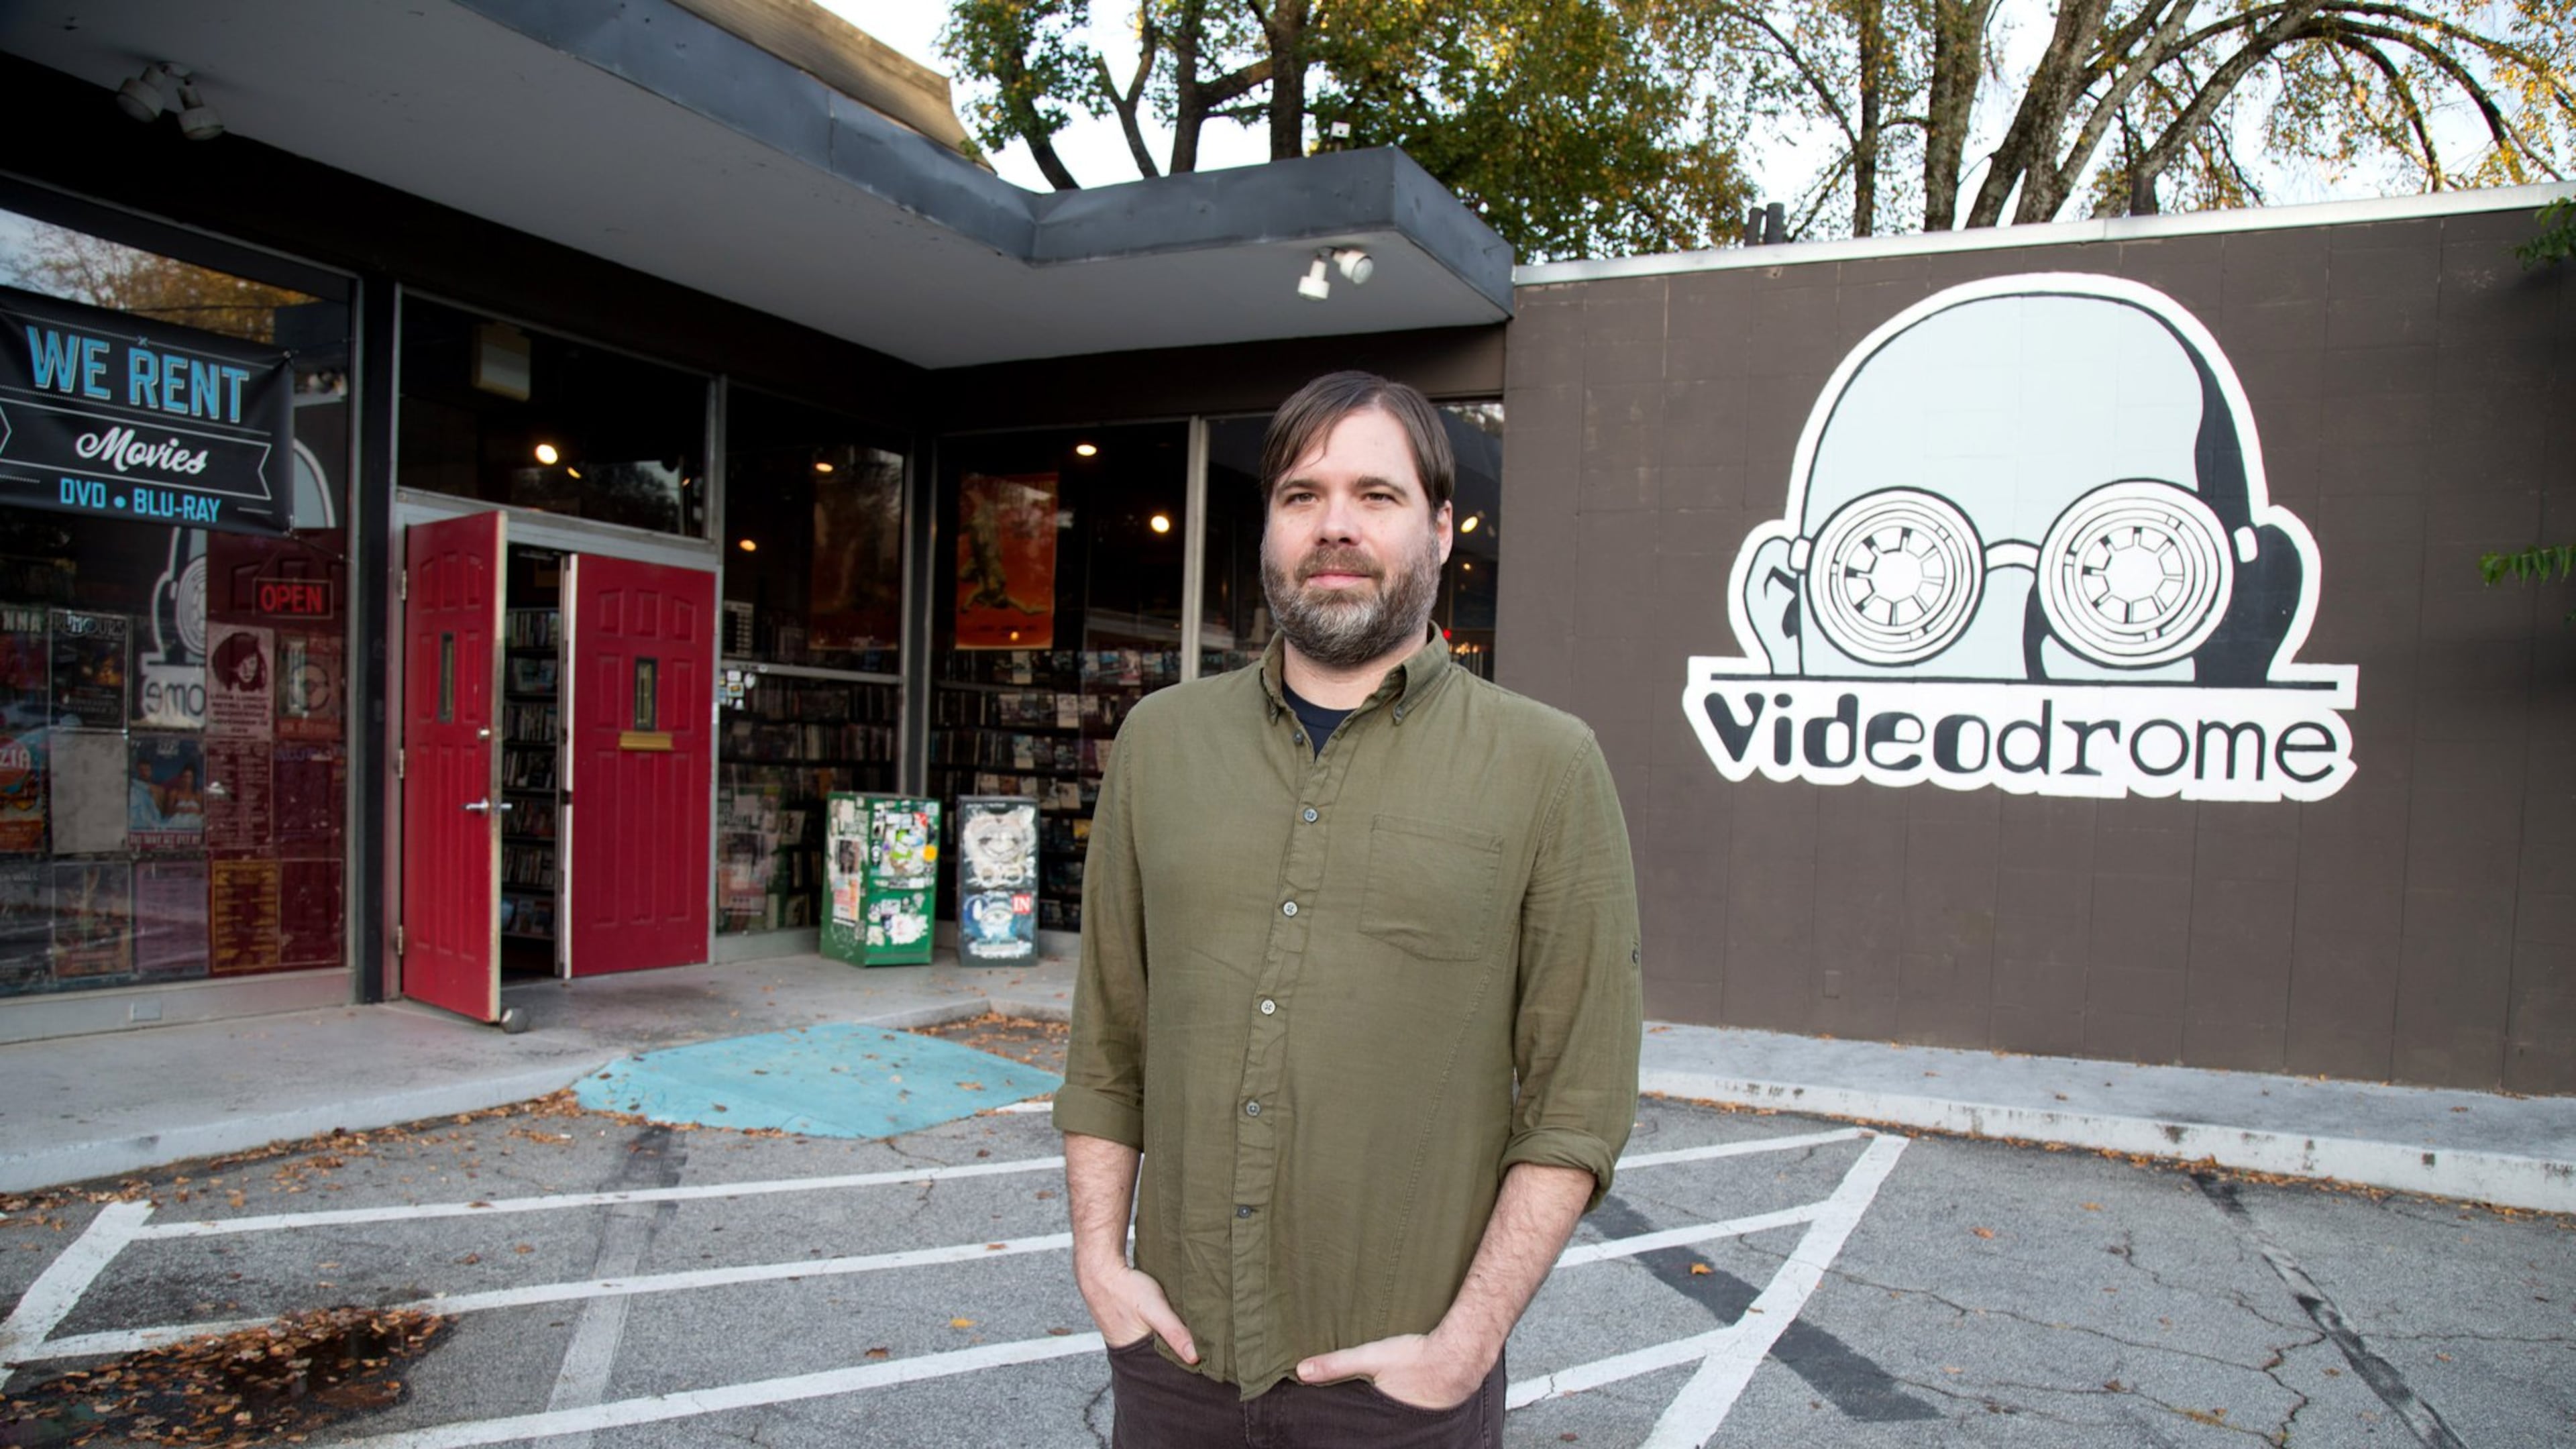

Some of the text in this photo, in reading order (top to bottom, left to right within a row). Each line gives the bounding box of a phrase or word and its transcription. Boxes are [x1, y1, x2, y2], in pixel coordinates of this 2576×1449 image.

[25, 325, 250, 423] WE RENT
[76, 427, 209, 475] Movies
[60, 477, 221, 523] DVD BLU-RAY
[260, 583, 323, 614] OPEN
